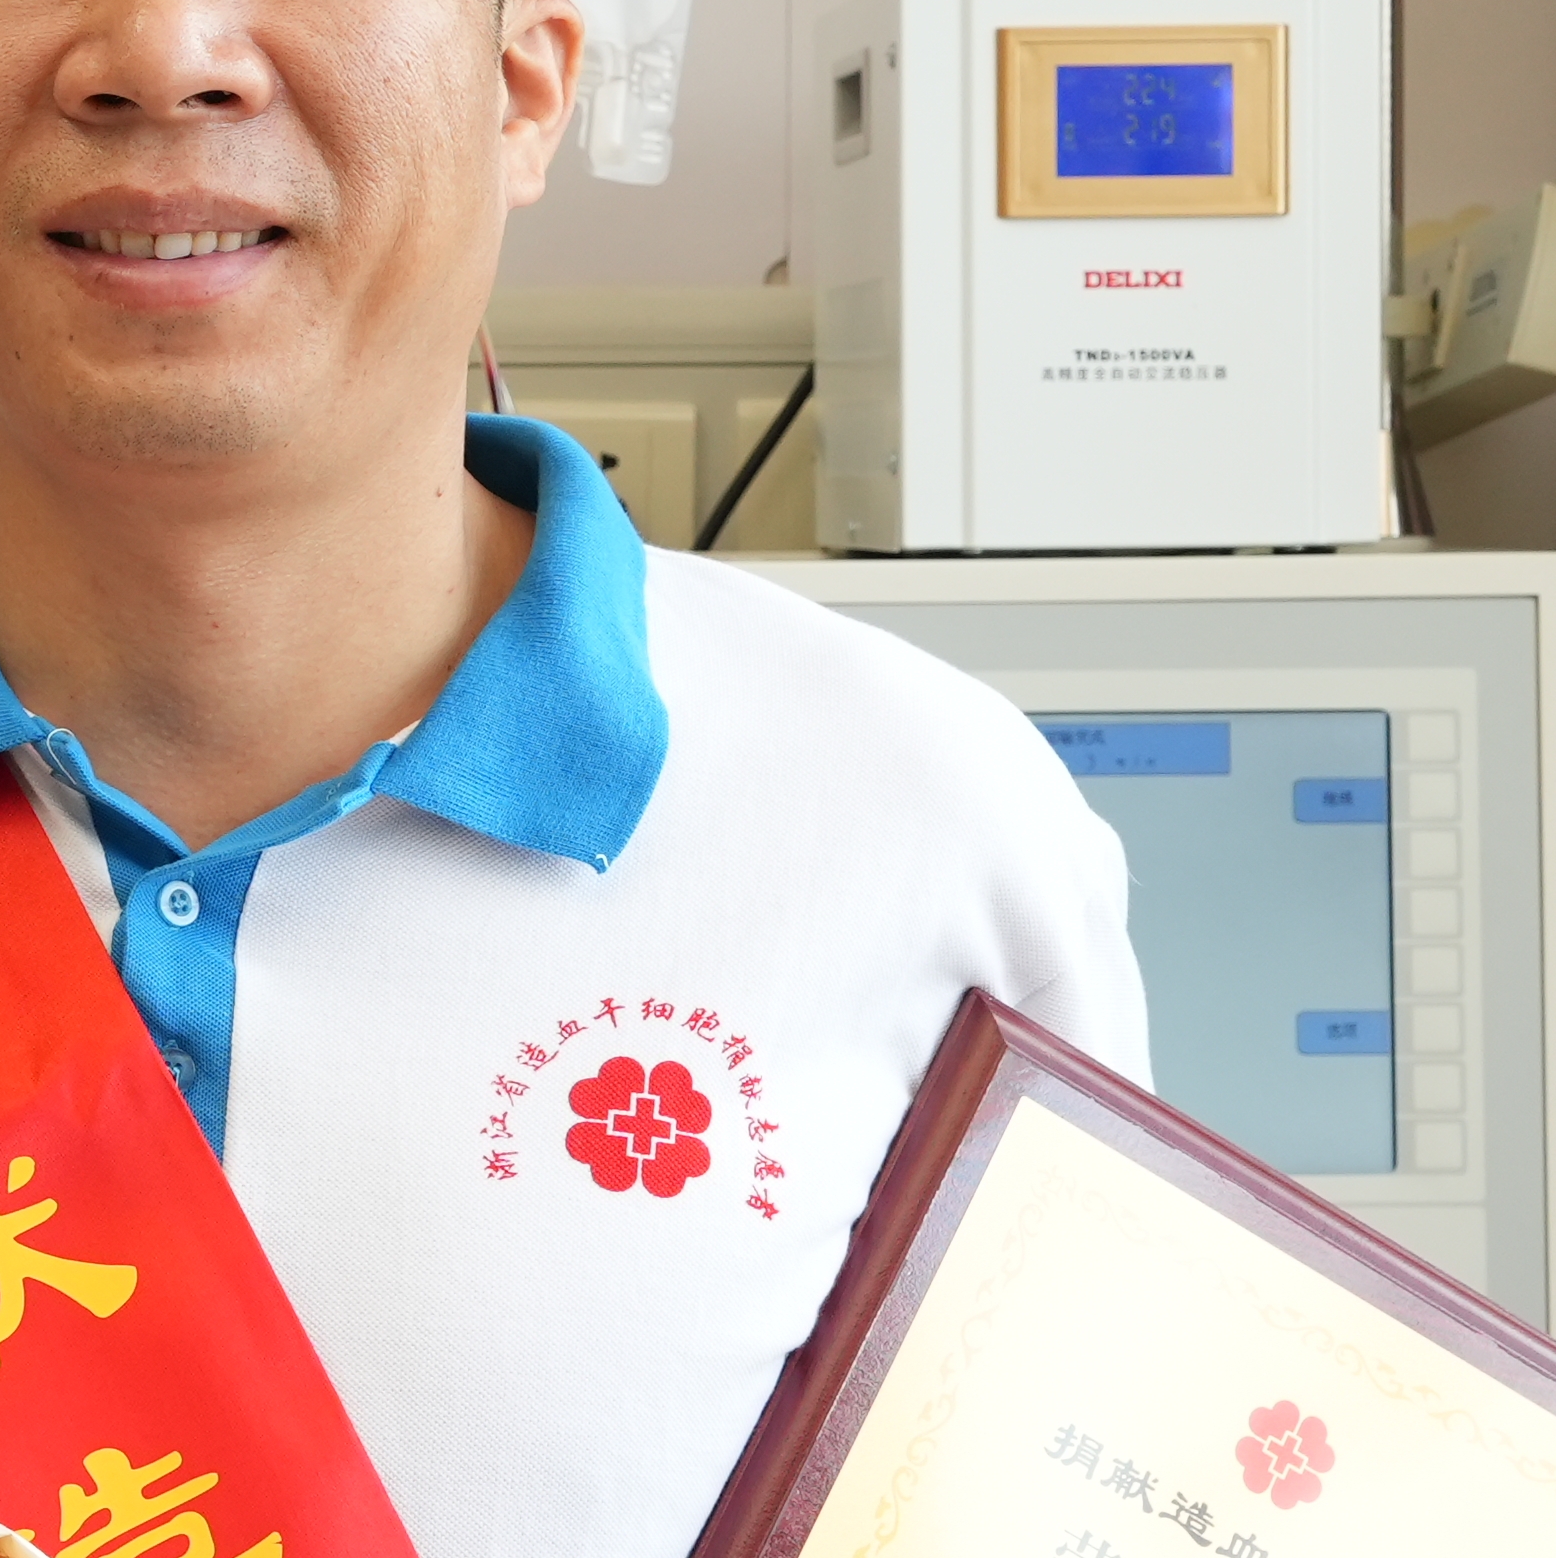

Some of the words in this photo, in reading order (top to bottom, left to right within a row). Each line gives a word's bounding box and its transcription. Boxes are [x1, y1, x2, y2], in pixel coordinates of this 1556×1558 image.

[1084, 269, 1185, 289] DELIXI
[480, 996, 787, 1221] 浙江省造血干细胞捐献志愿者
